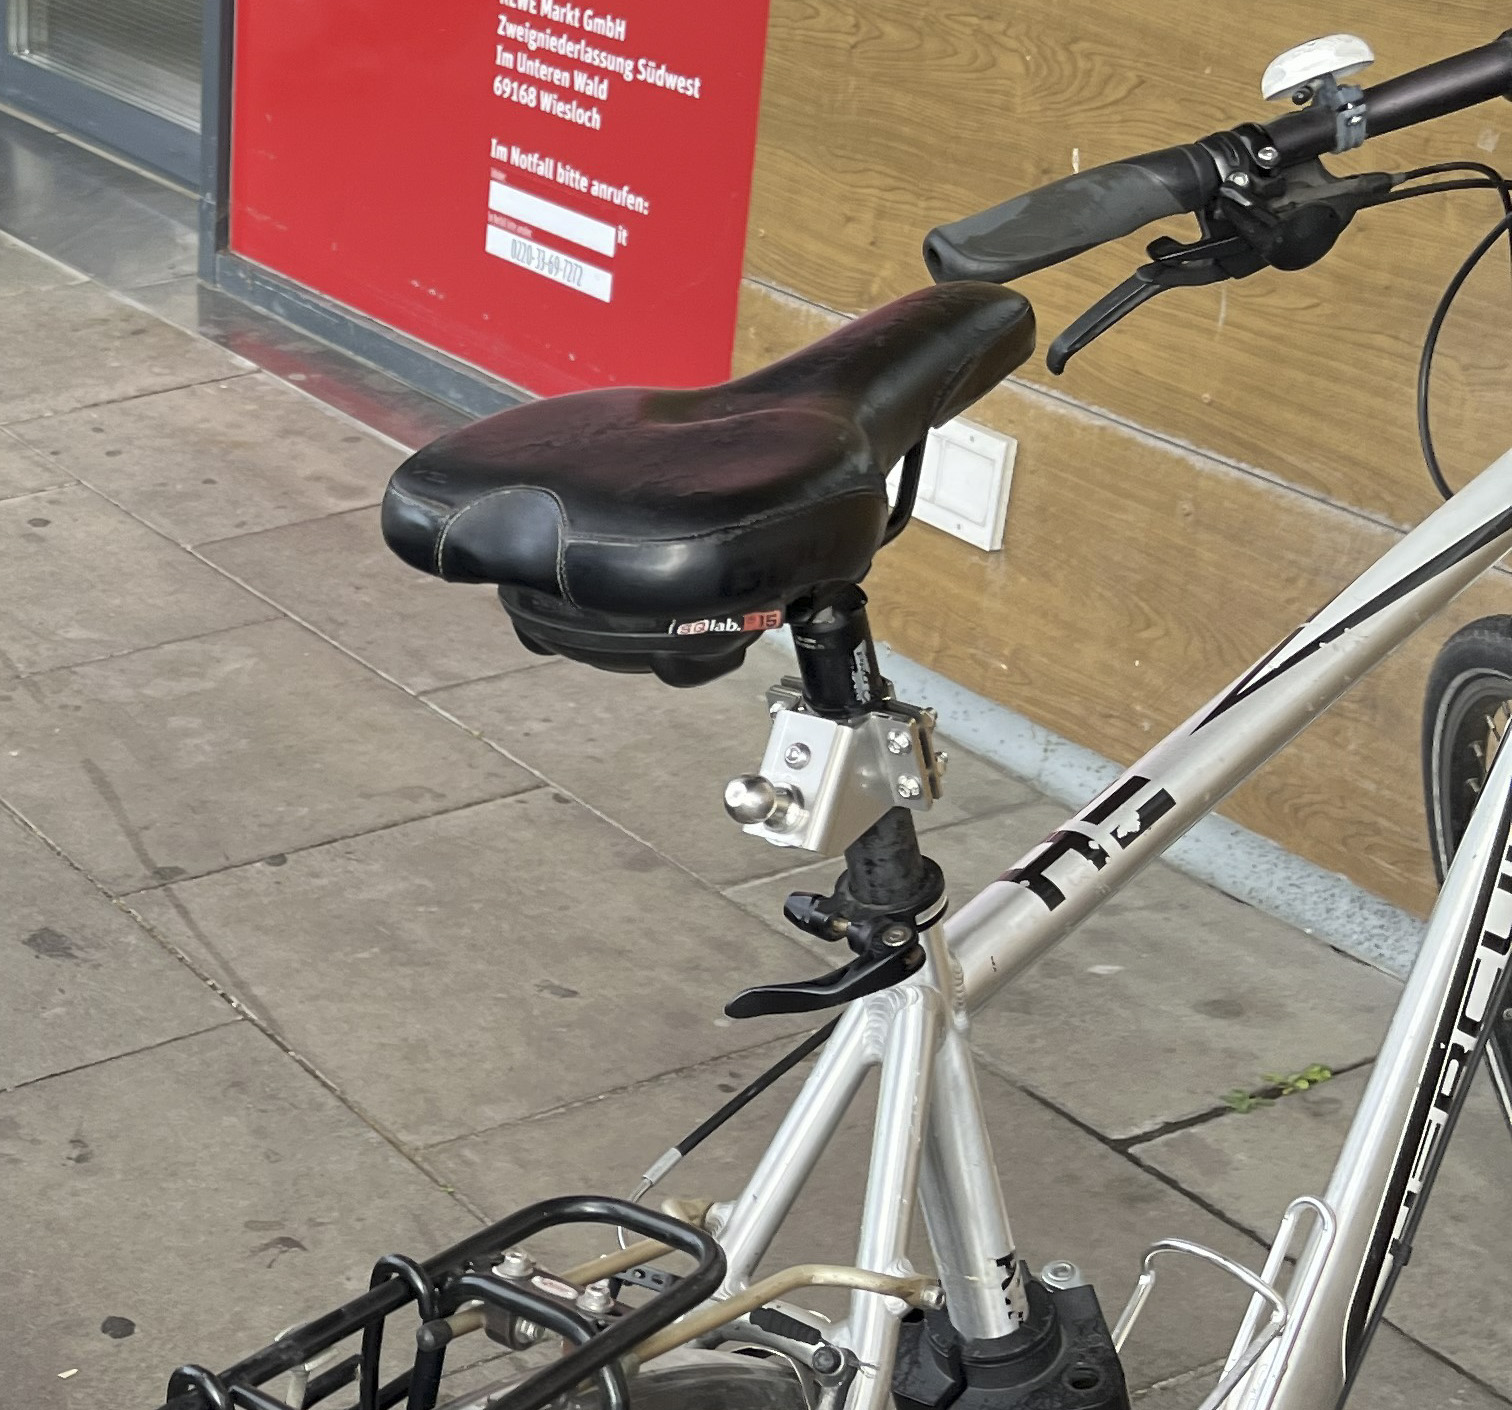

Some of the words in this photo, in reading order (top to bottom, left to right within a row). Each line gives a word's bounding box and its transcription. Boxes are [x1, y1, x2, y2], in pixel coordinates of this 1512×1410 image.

[539, 0, 581, 28] Markt
[583, 9, 627, 41] GmbH
[495, 44, 514, 70] Im
[516, 51, 571, 88] Unteren
[573, 69, 609, 101] Wald
[497, 14, 635, 82] Zweigniederlassung
[637, 57, 701, 99] Südwest
[493, 75, 537, 108] 69168
[539, 89, 601, 130] Wiesloch
[490, 138, 508, 162] Im
[510, 145, 554, 180] Notfall
[556, 162, 589, 193] bitte
[590, 180, 649, 215] anrufen:
